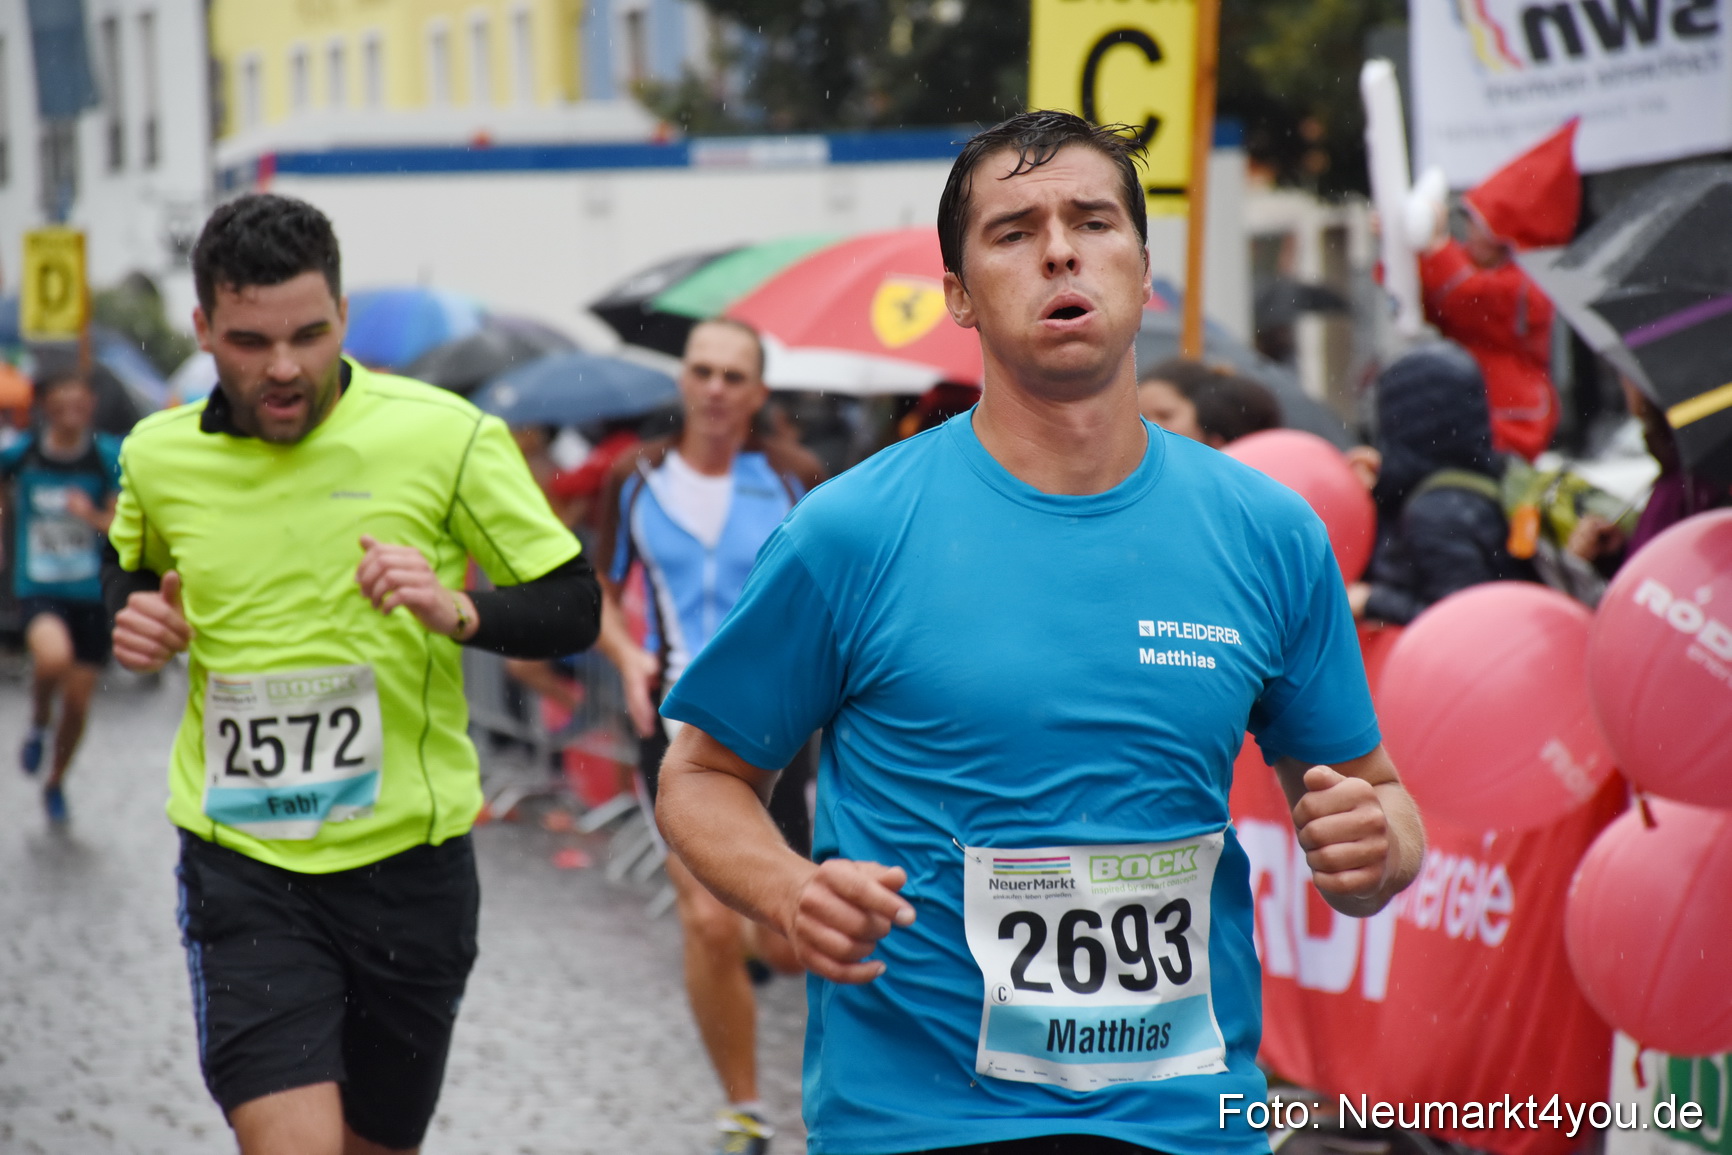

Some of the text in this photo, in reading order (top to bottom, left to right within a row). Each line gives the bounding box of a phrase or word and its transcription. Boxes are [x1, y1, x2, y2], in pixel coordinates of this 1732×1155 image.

[1081, 28, 1162, 150] C
[38, 259, 74, 314] D
[1157, 620, 1242, 646] PFLEIDERER
[1139, 648, 1216, 670] Matthias
[219, 706, 365, 778] 2572
[1089, 845, 1200, 883] BOCK
[989, 877, 1076, 891] NeuerMarkt
[1091, 883, 1126, 895] inspired
[1128, 882, 1139, 893] by
[1394, 829, 1515, 948] nergie
[998, 898, 1193, 994] 2693
[1046, 1018, 1171, 1054] Matthias
